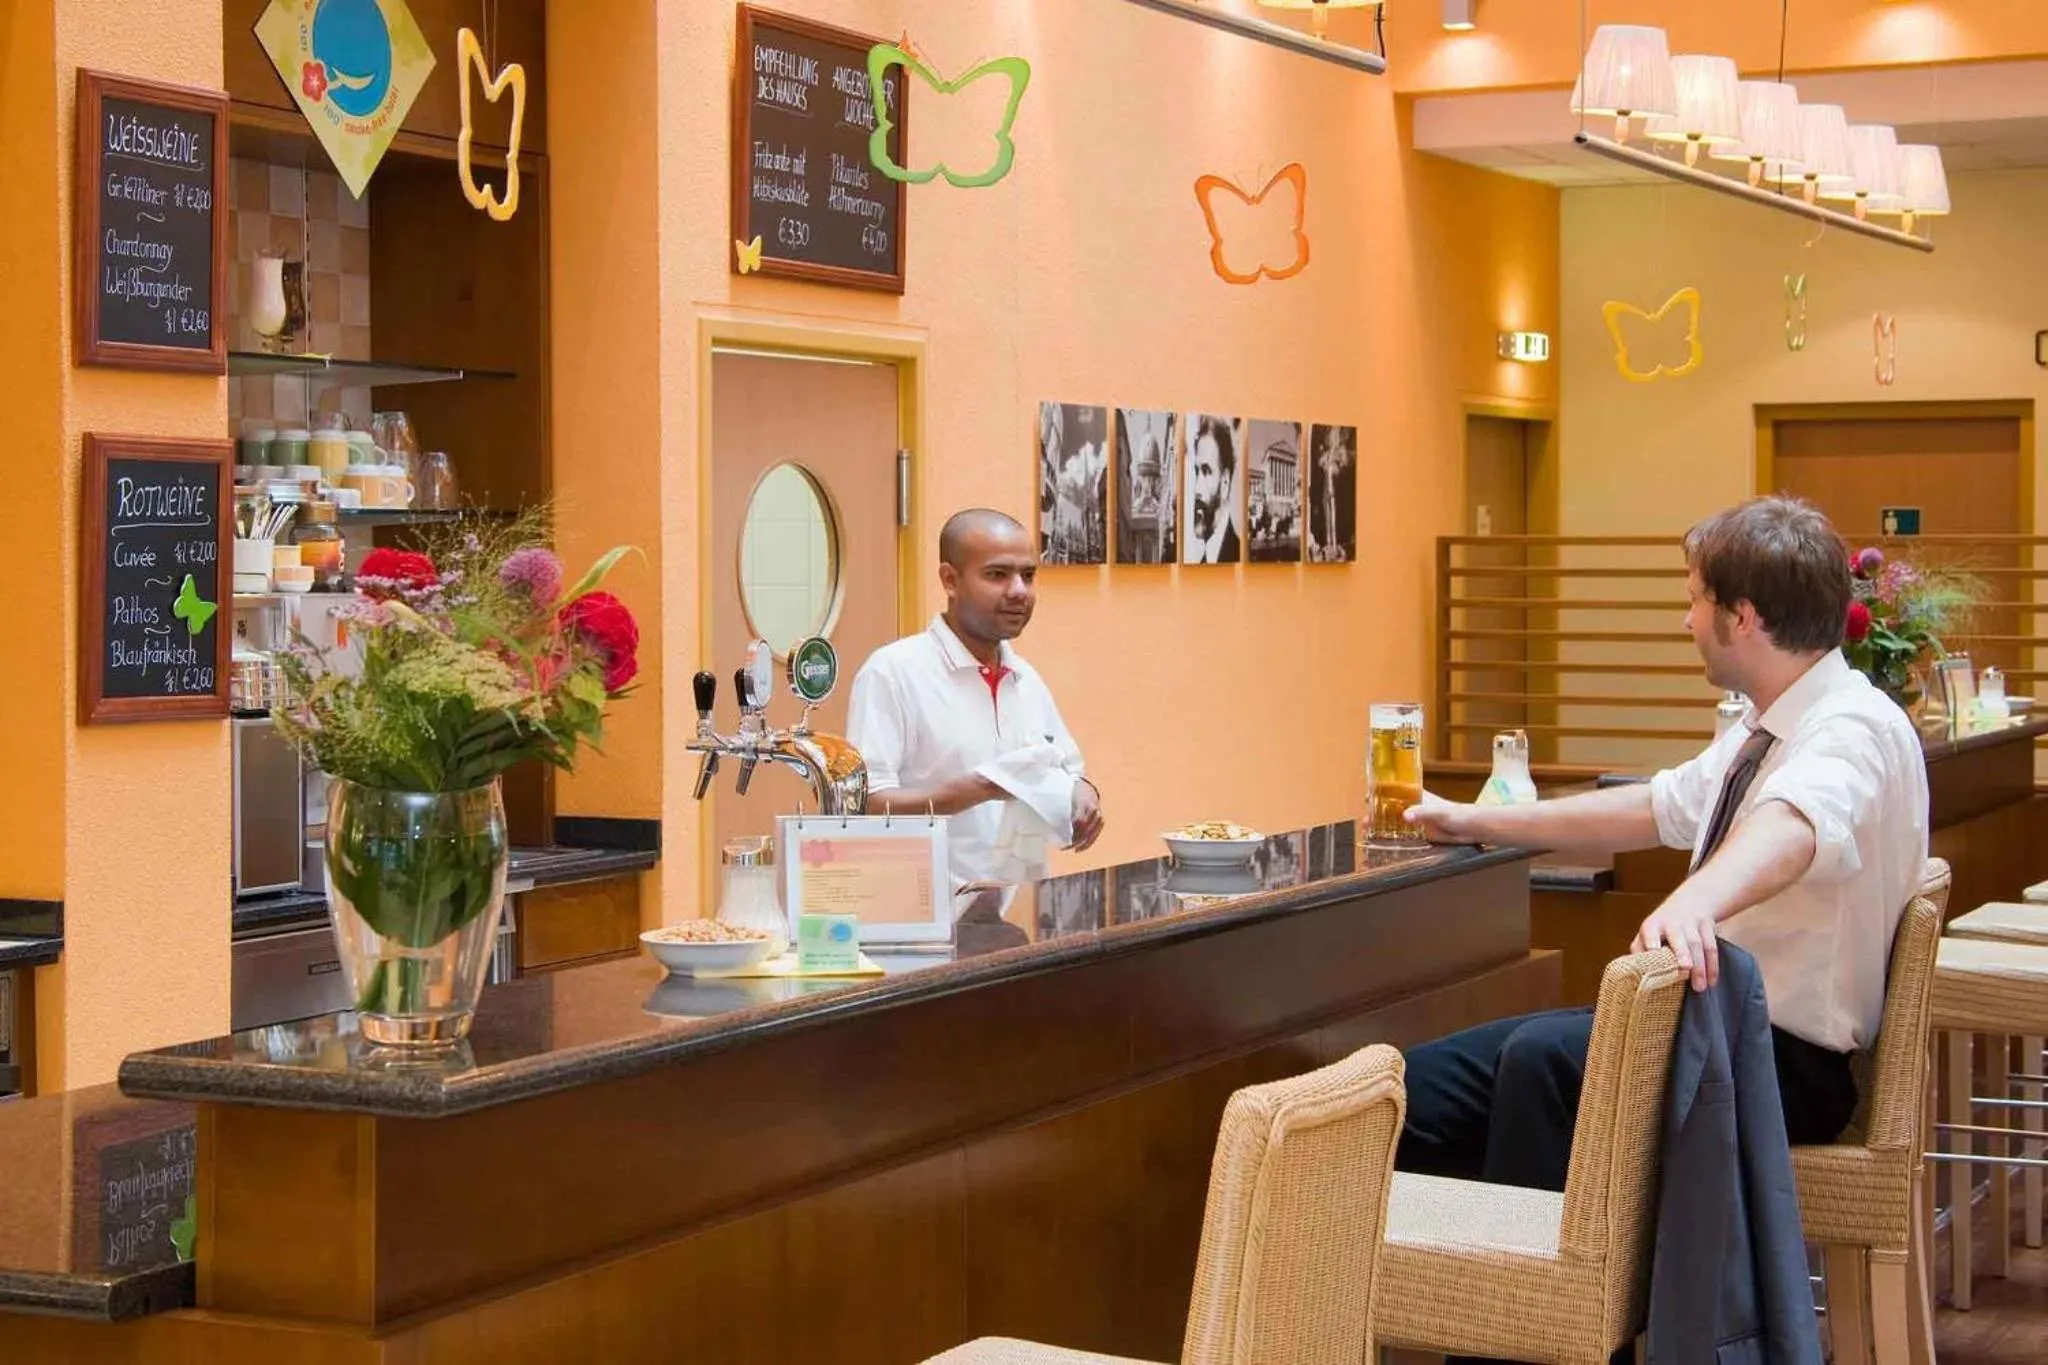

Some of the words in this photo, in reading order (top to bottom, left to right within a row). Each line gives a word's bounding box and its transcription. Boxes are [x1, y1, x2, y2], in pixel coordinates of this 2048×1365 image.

[105, 228, 174, 272] Chardonnay
[114, 541, 157, 568] Cuvée
[112, 595, 160, 626] Pathos
[111, 635, 198, 678] Blaufränkisch
